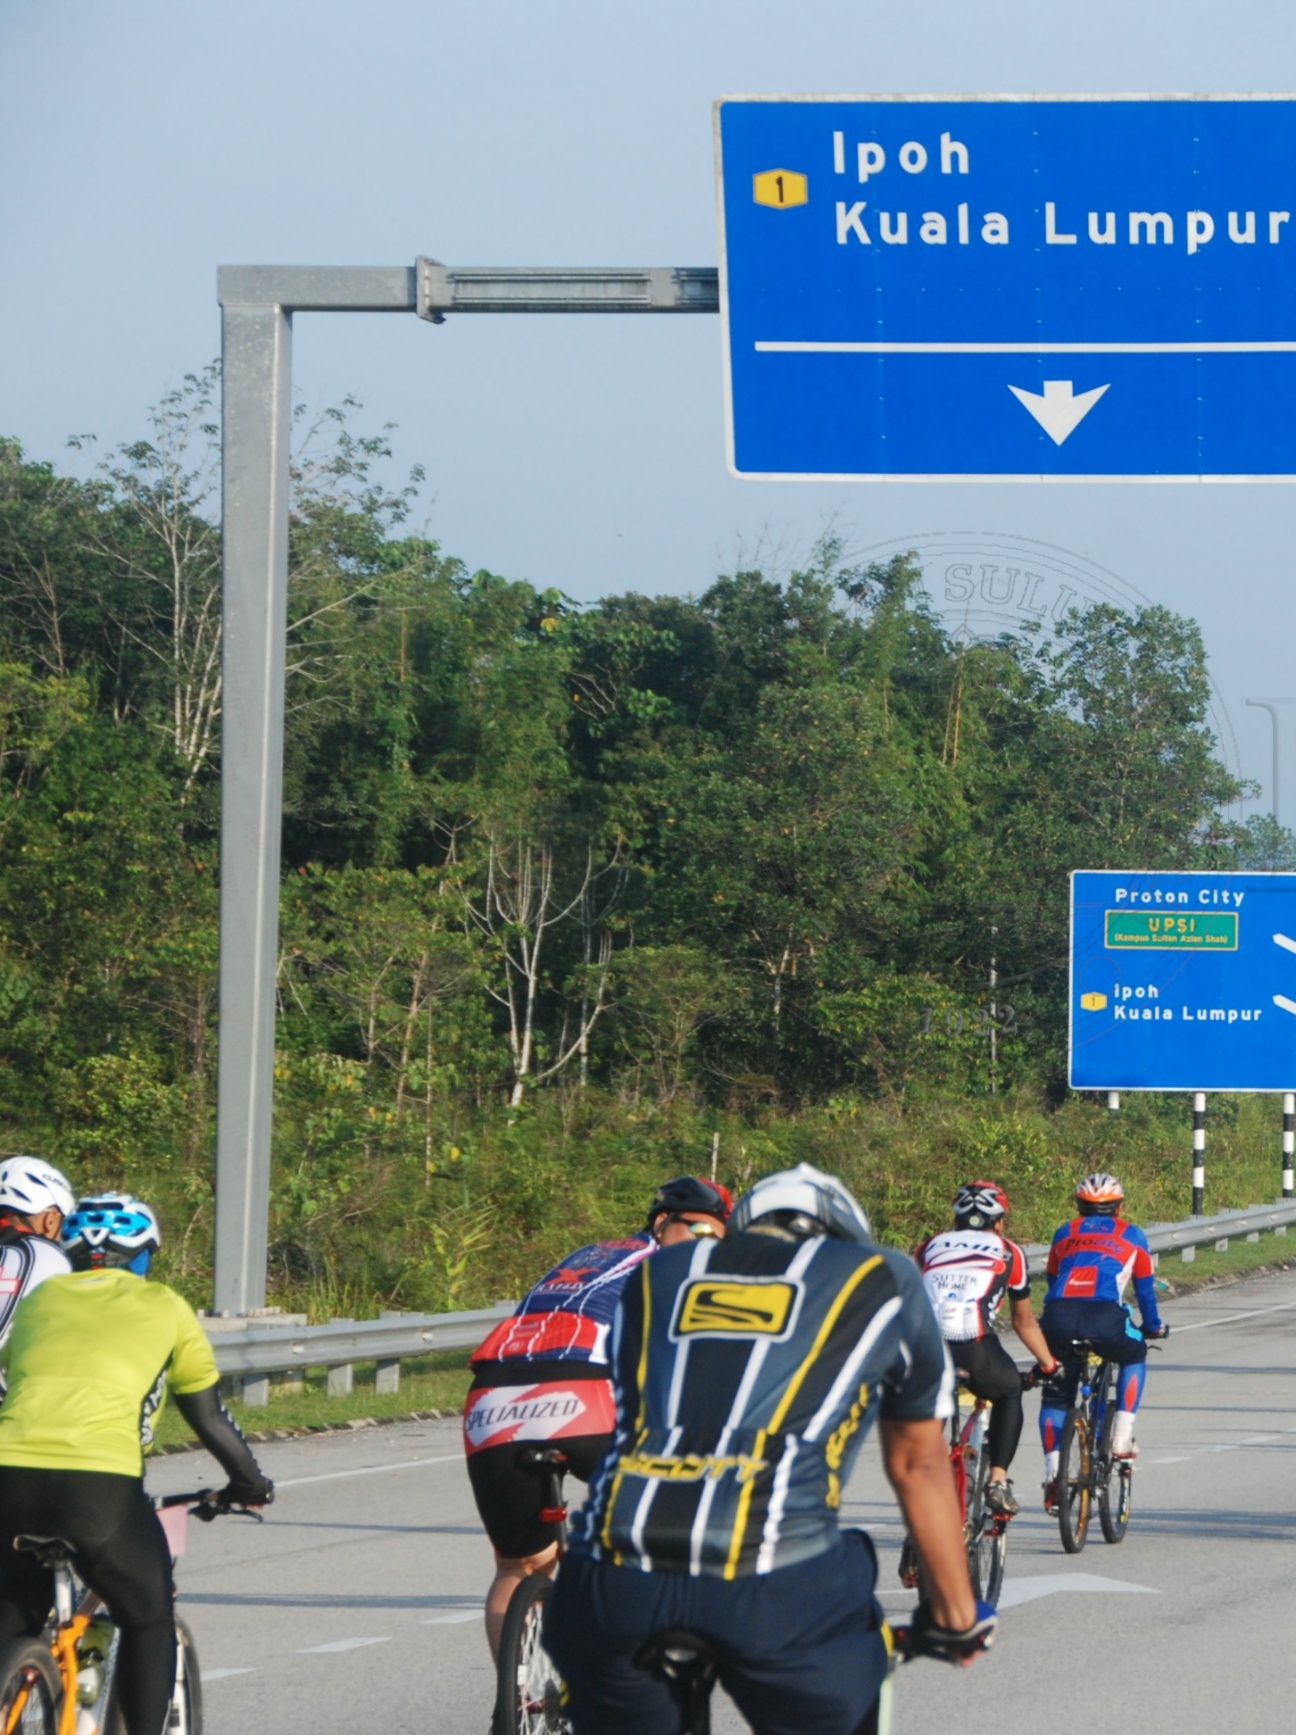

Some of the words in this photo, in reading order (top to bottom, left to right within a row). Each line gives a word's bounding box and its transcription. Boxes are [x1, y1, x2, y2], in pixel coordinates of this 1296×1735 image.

[833, 131, 970, 183] Ipoh
[775, 177, 784, 203] 1
[835, 202, 1010, 245] Kuala
[1044, 202, 1290, 255] Lumpur
[1115, 888, 1189, 904] Proton
[1198, 889, 1245, 907] City
[1148, 917, 1196, 933] UPSI
[1114, 933, 1149, 942] (Kampus
[1152, 934, 1178, 942] Sultan
[1180, 935, 1203, 943] Azlan
[1205, 935, 1228, 944] Shah)
[1114, 984, 1159, 1001] Ipoh
[1113, 1006, 1174, 1021] Kuala
[1182, 1006, 1262, 1024] Lumpur
[931, 1272, 977, 1286] SUTTER
[937, 1280, 967, 1291] HOME
[466, 1398, 580, 1431] SPECIALIZED
